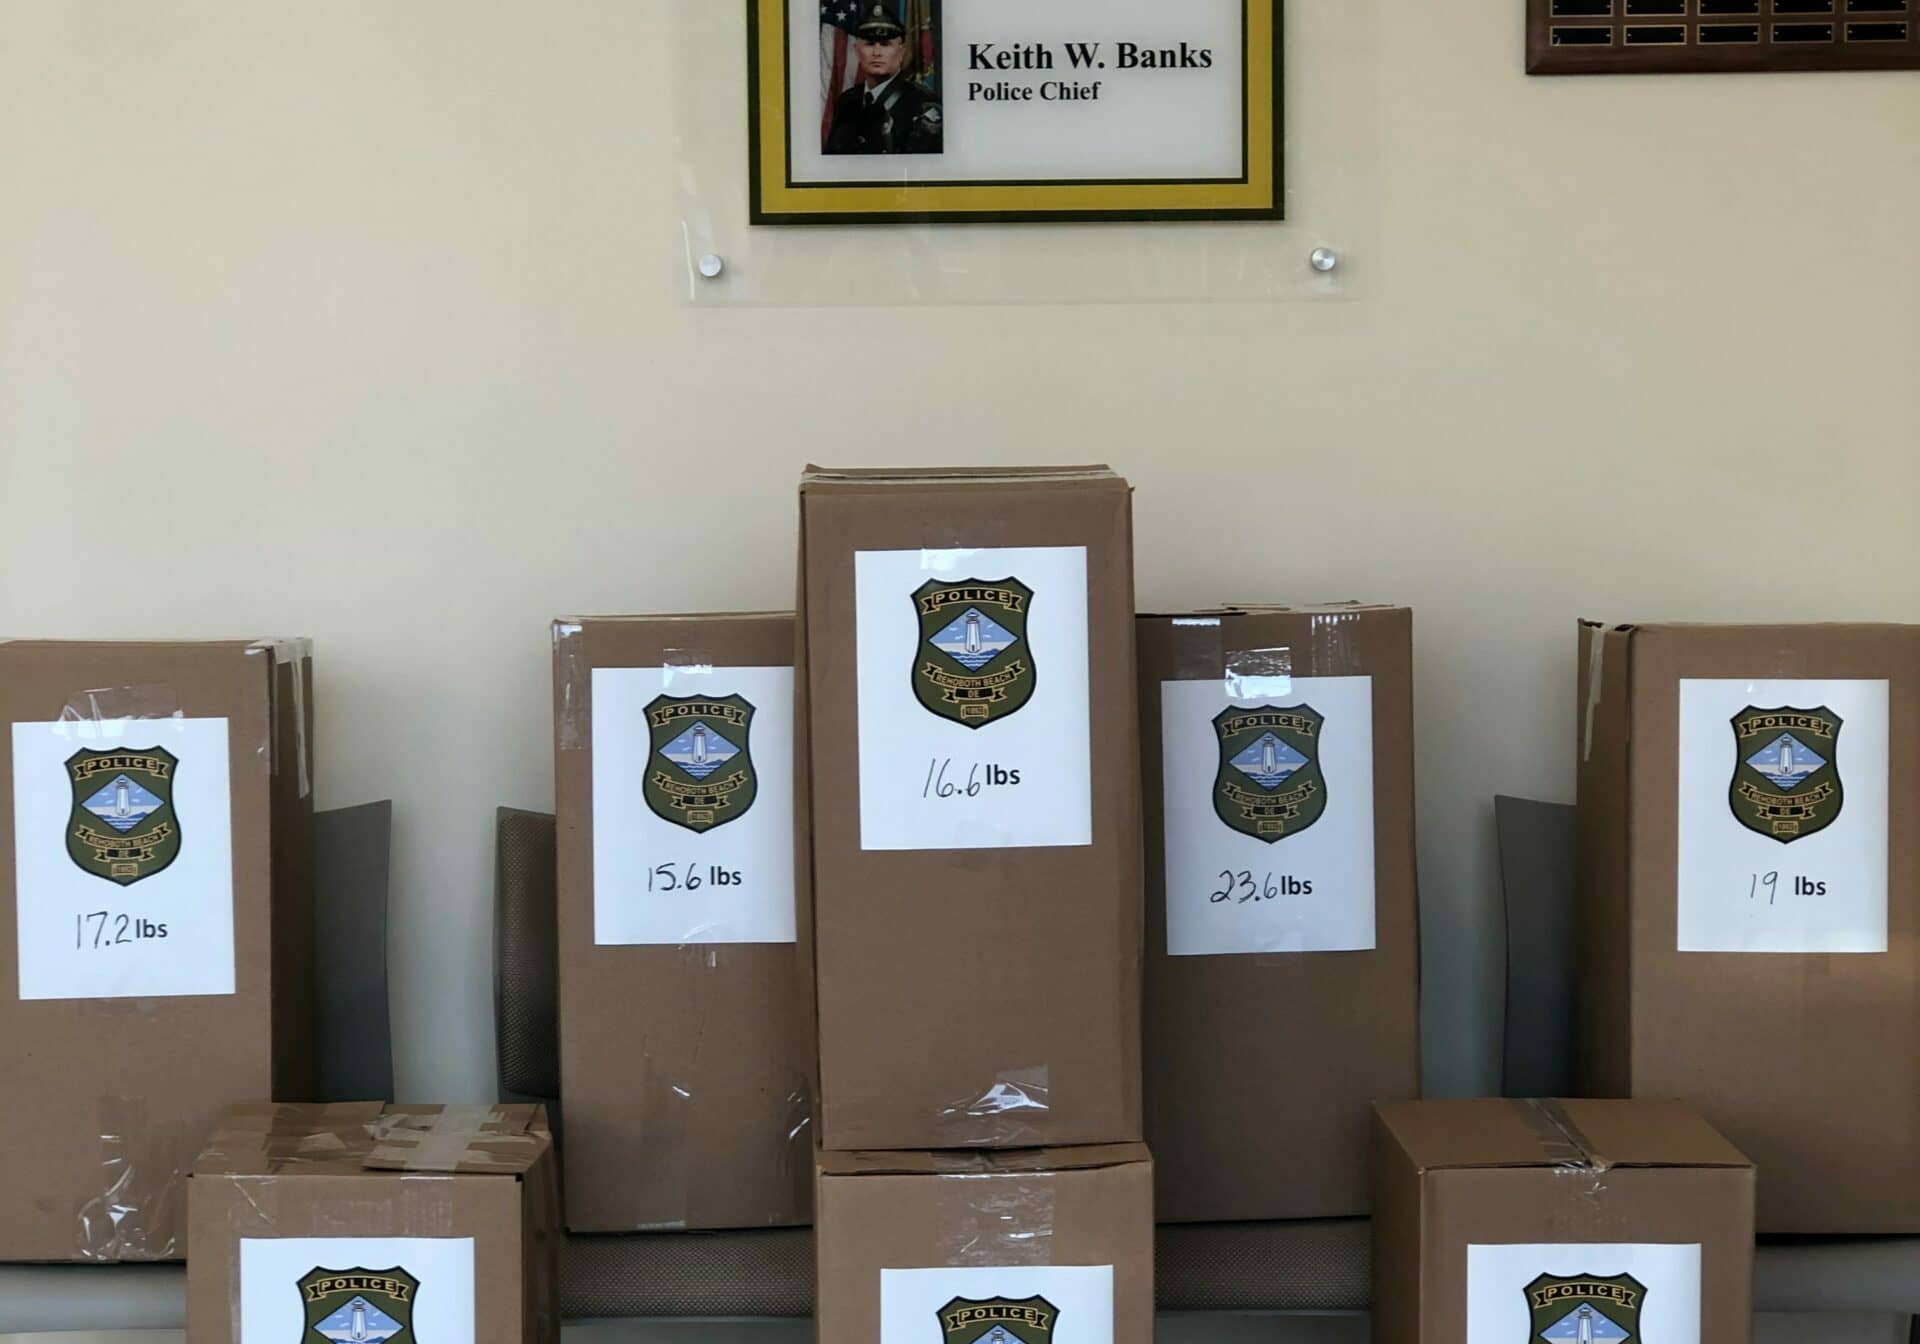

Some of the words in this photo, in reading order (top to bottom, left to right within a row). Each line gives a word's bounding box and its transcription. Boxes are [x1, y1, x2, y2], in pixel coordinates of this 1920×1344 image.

[968, 43, 1053, 70] Keith
[1064, 42, 1105, 69] W.
[1116, 41, 1212, 69] Banks
[968, 81, 1033, 101] Police
[1040, 81, 1102, 101] Chief
[935, 590, 1009, 603] POLICE
[983, 673, 1010, 686] BEACH
[666, 706, 734, 717] POLICE
[1234, 717, 1301, 728] POLICE
[1753, 717, 1820, 729] POLICE
[87, 758, 157, 770] POLICE
[923, 758, 980, 798] 16.6
[986, 763, 1020, 785] lbs
[648, 862, 702, 892] 15.6
[710, 865, 742, 885] lbs
[1210, 870, 1278, 904] 23.6
[1281, 875, 1313, 895] lbs
[1750, 871, 1778, 905] 19
[1795, 875, 1826, 896] lbs
[77, 911, 132, 950] 17.2
[136, 918, 168, 938] lbs
[321, 1279, 396, 1291] POLICE
[1548, 1285, 1621, 1298] POLICE
[961, 1308, 1034, 1320] POLICE
